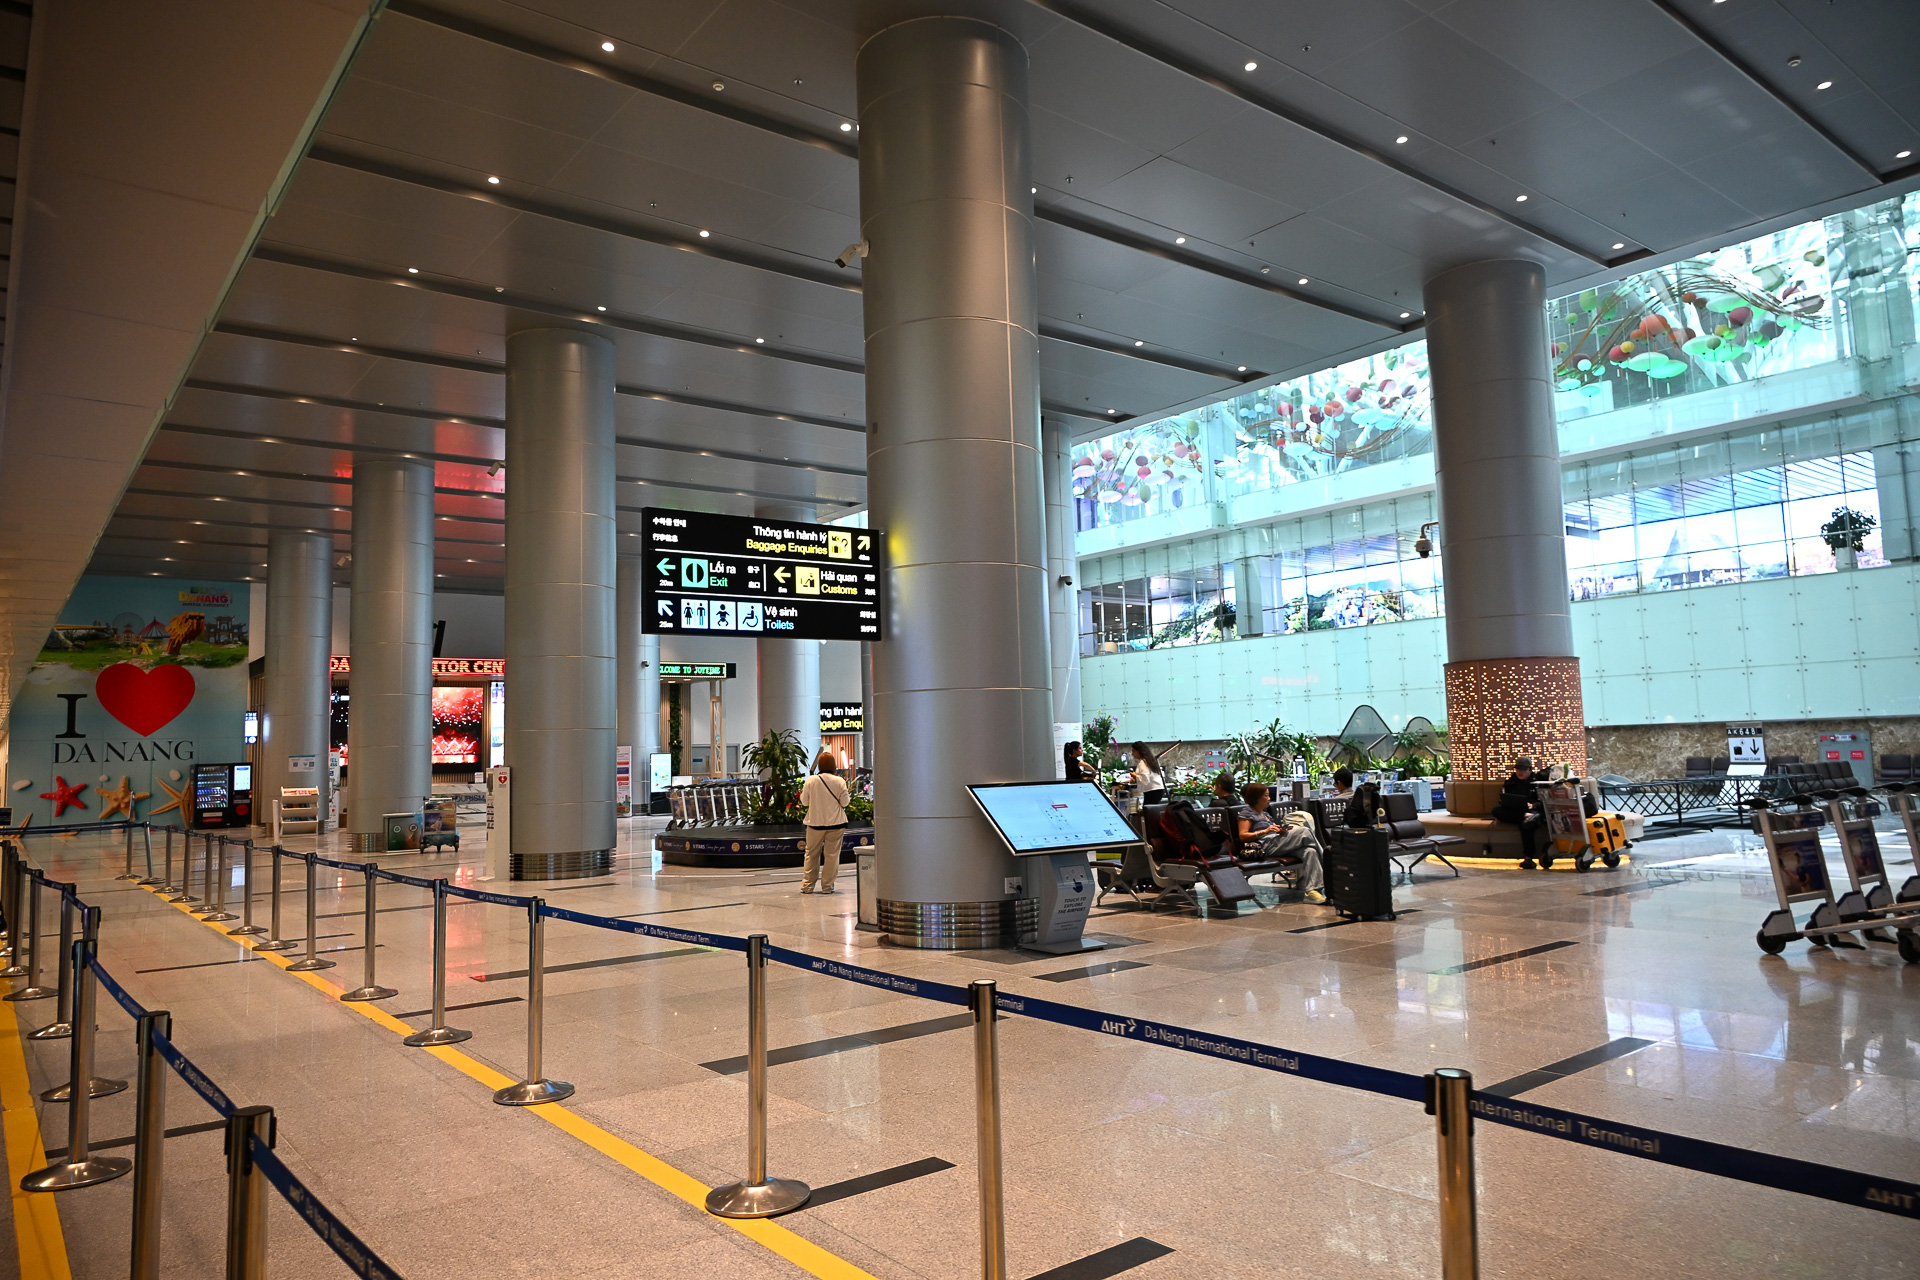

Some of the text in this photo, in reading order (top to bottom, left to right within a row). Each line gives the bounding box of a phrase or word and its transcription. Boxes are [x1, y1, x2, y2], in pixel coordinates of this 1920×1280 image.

[753, 525, 827, 544] Thông tin hành lý
[746, 539, 828, 555] Baggage Enquiries
[709, 561, 736, 574] Lối ra
[709, 576, 728, 587] Exit
[820, 571, 858, 584] Hải quan
[821, 584, 858, 595] Customs
[764, 606, 798, 617] Vệ sinh
[764, 619, 795, 630] Toilets
[682, 666, 692, 674] TO
[55, 693, 88, 739] I
[52, 740, 194, 764] DA NANG
[669, 929, 698, 942] International
[828, 963, 838, 973] Da
[838, 965, 853, 979] Nang
[853, 969, 890, 986] International
[890, 977, 918, 992] Terminal
[1101, 1019, 1299, 1071] AHT Da Nang International Terminal
[1577, 1121, 1661, 1155] Terminal
